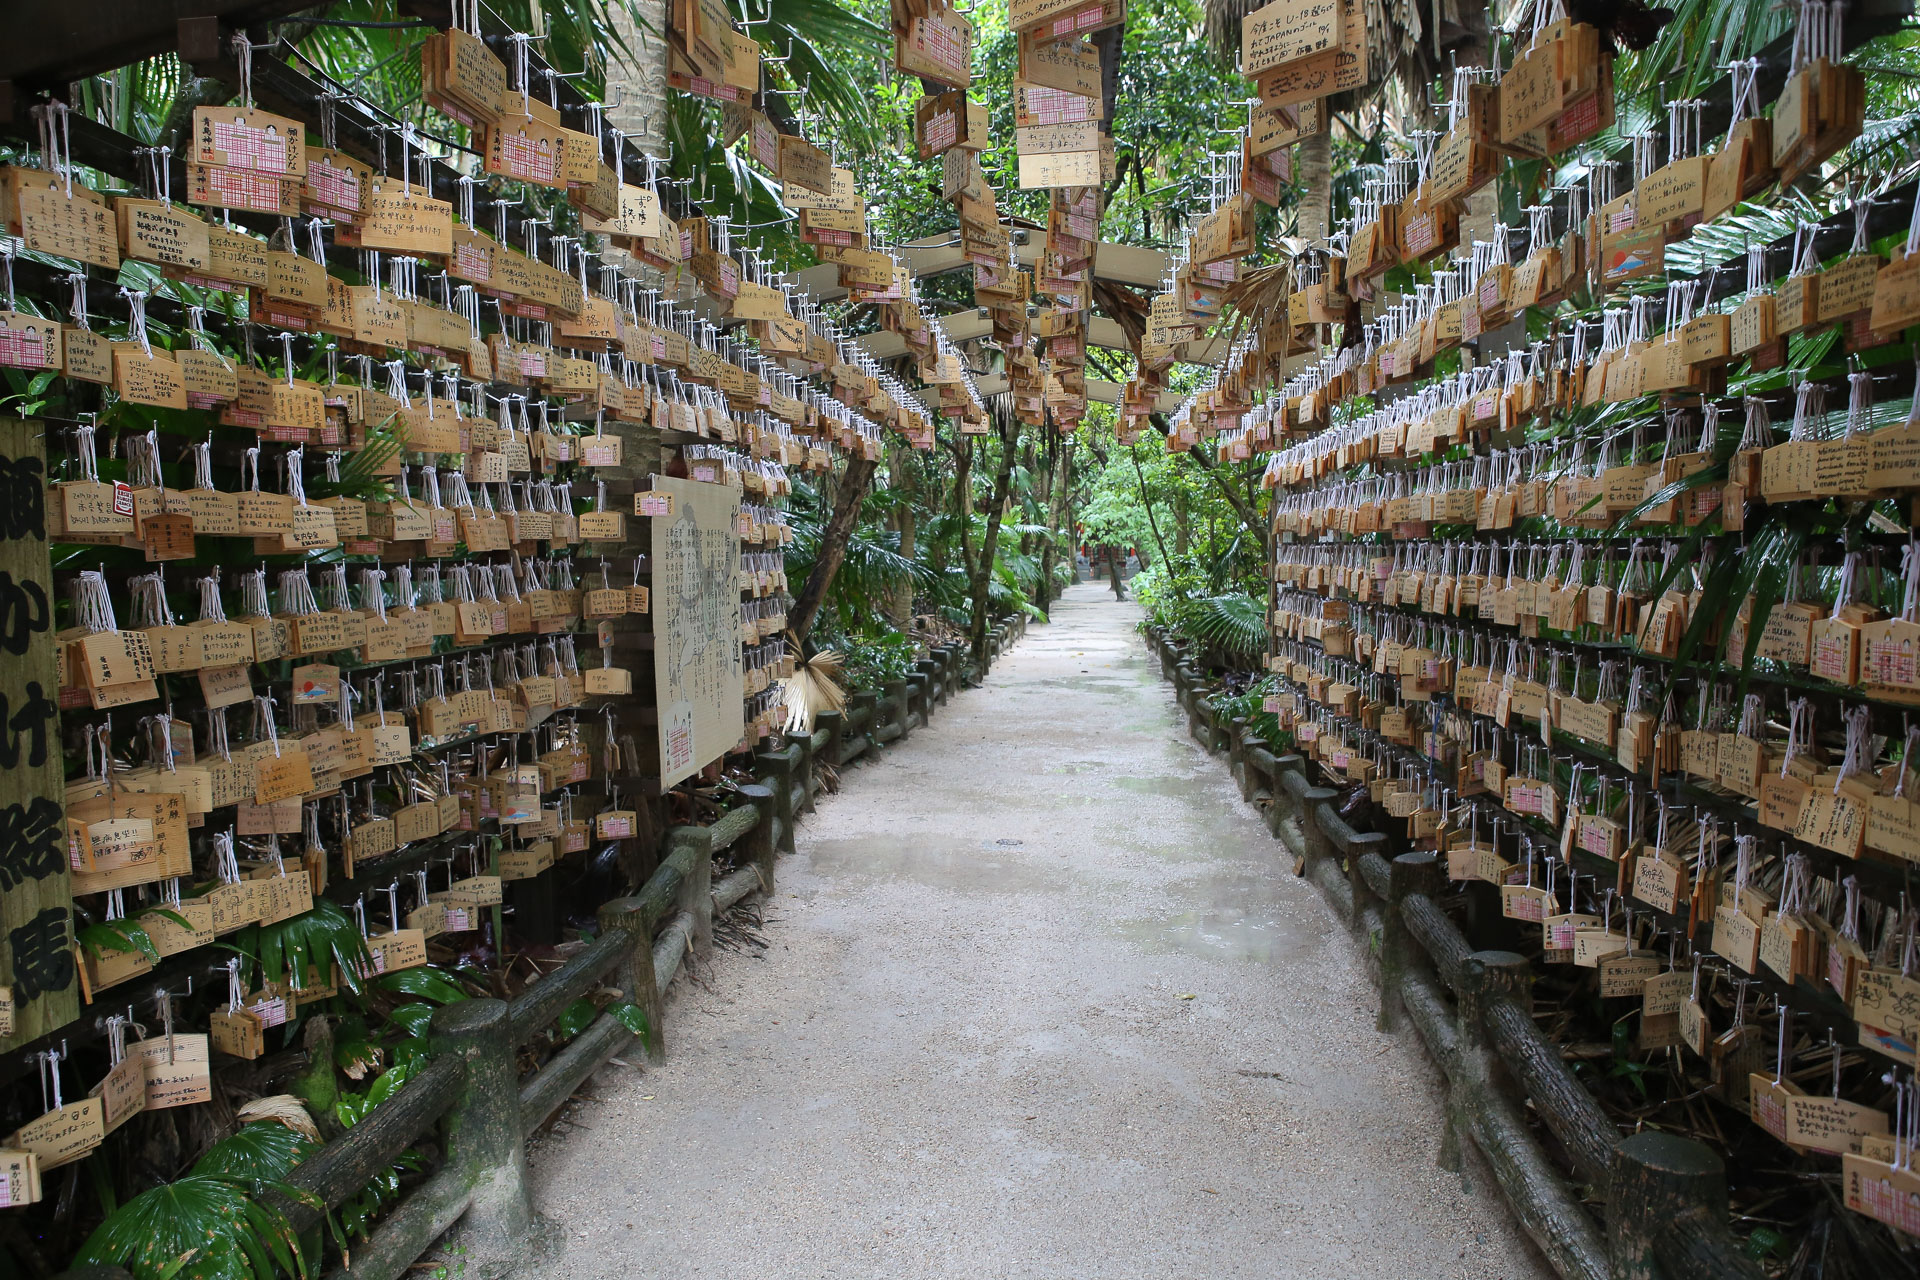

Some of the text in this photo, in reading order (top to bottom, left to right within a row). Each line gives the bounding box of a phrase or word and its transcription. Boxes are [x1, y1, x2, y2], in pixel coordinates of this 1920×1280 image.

[1017, 87, 1028, 119] 青島神社
[201, 116, 213, 153] 青島神社
[286, 126, 298, 171] 願かけびな
[492, 127, 501, 164] 青島神社
[554, 136, 564, 179] 願かけびな
[359, 170, 368, 209] 願かけびな
[45, 327, 55, 365] 願かけびな
[0, 455, 74, 1008] 願かけ絵馬
[1641, 863, 1665, 884] 家内安全
[10, 1163, 20, 1201] 願かけびな
